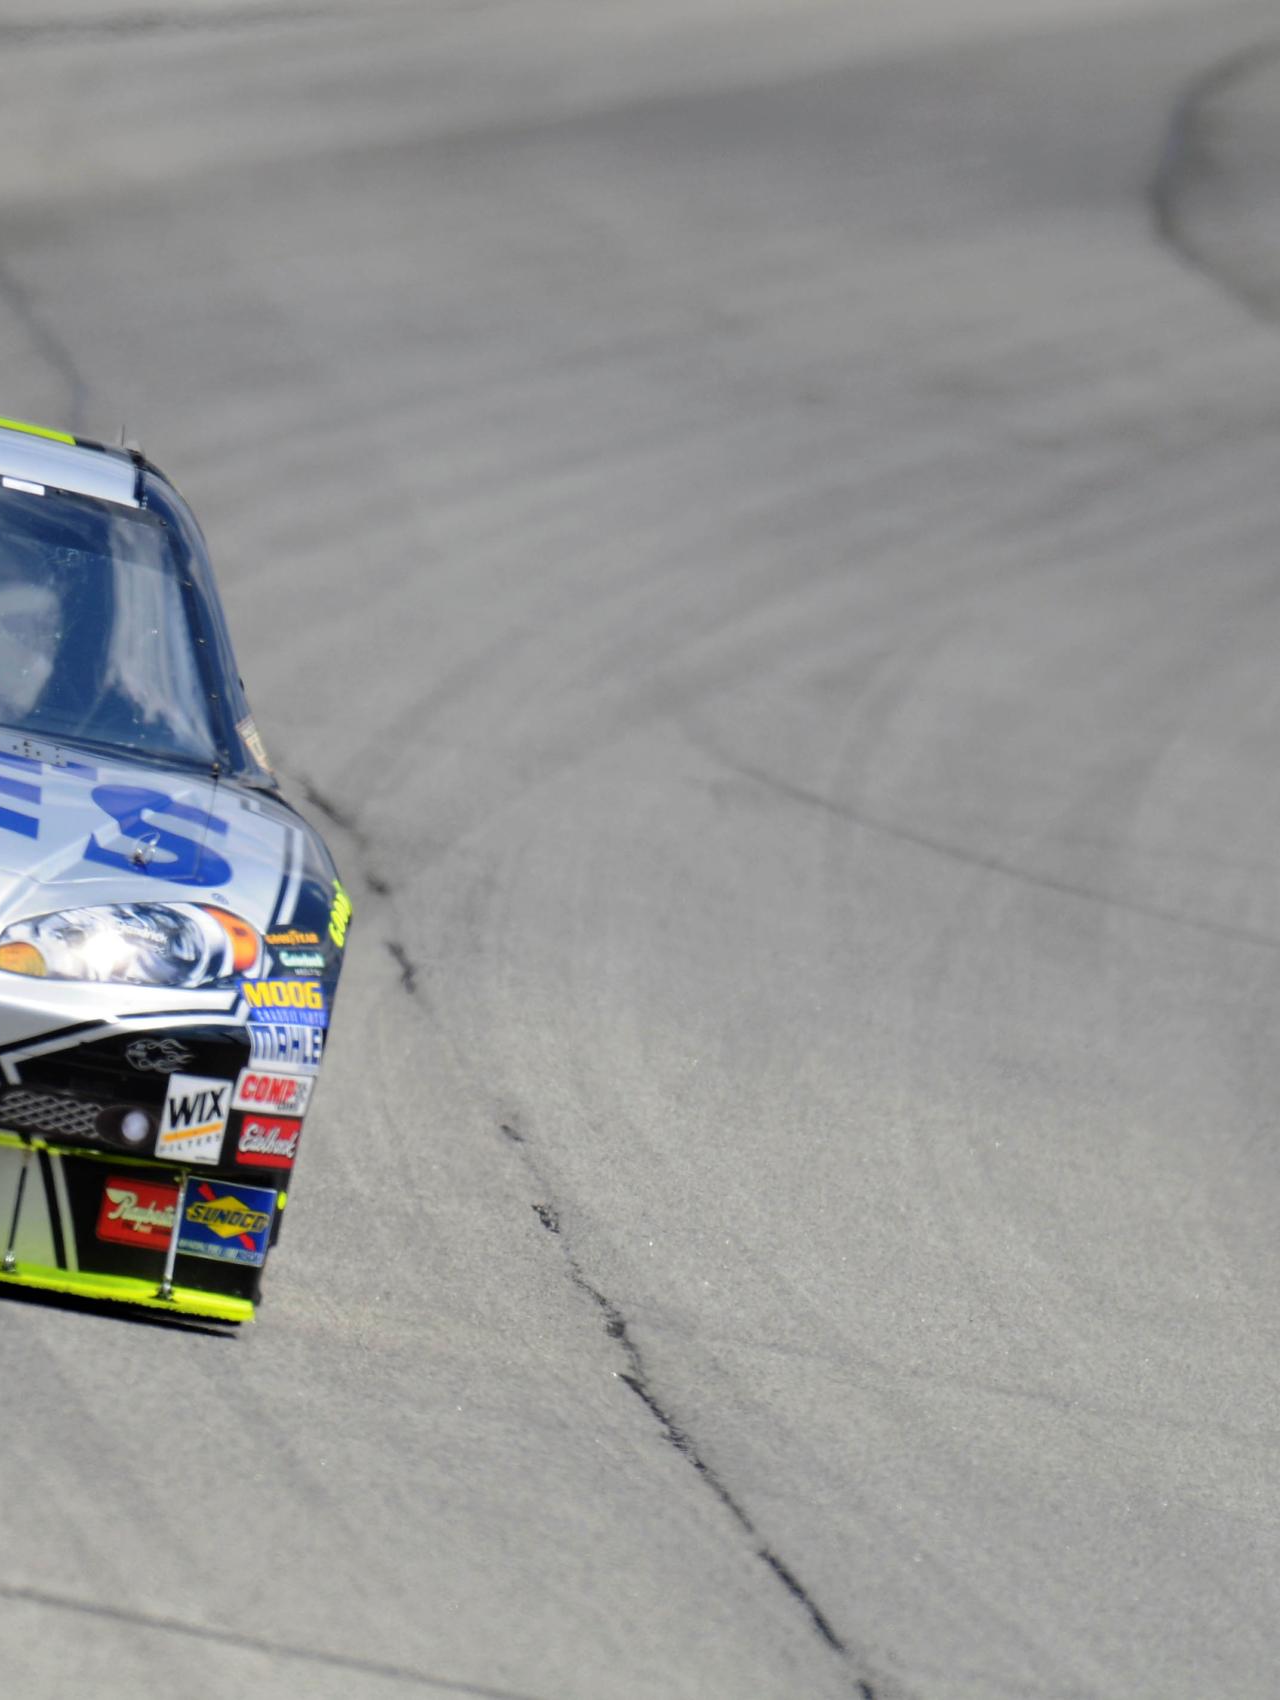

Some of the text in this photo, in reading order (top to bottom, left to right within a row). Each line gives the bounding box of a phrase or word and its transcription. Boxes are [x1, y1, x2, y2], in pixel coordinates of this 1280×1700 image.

[242, 981, 324, 1010] MOOG
[240, 1073, 298, 1105] COMP
[169, 1086, 227, 1130] WIX
[188, 1203, 268, 1232] SUNOCO
